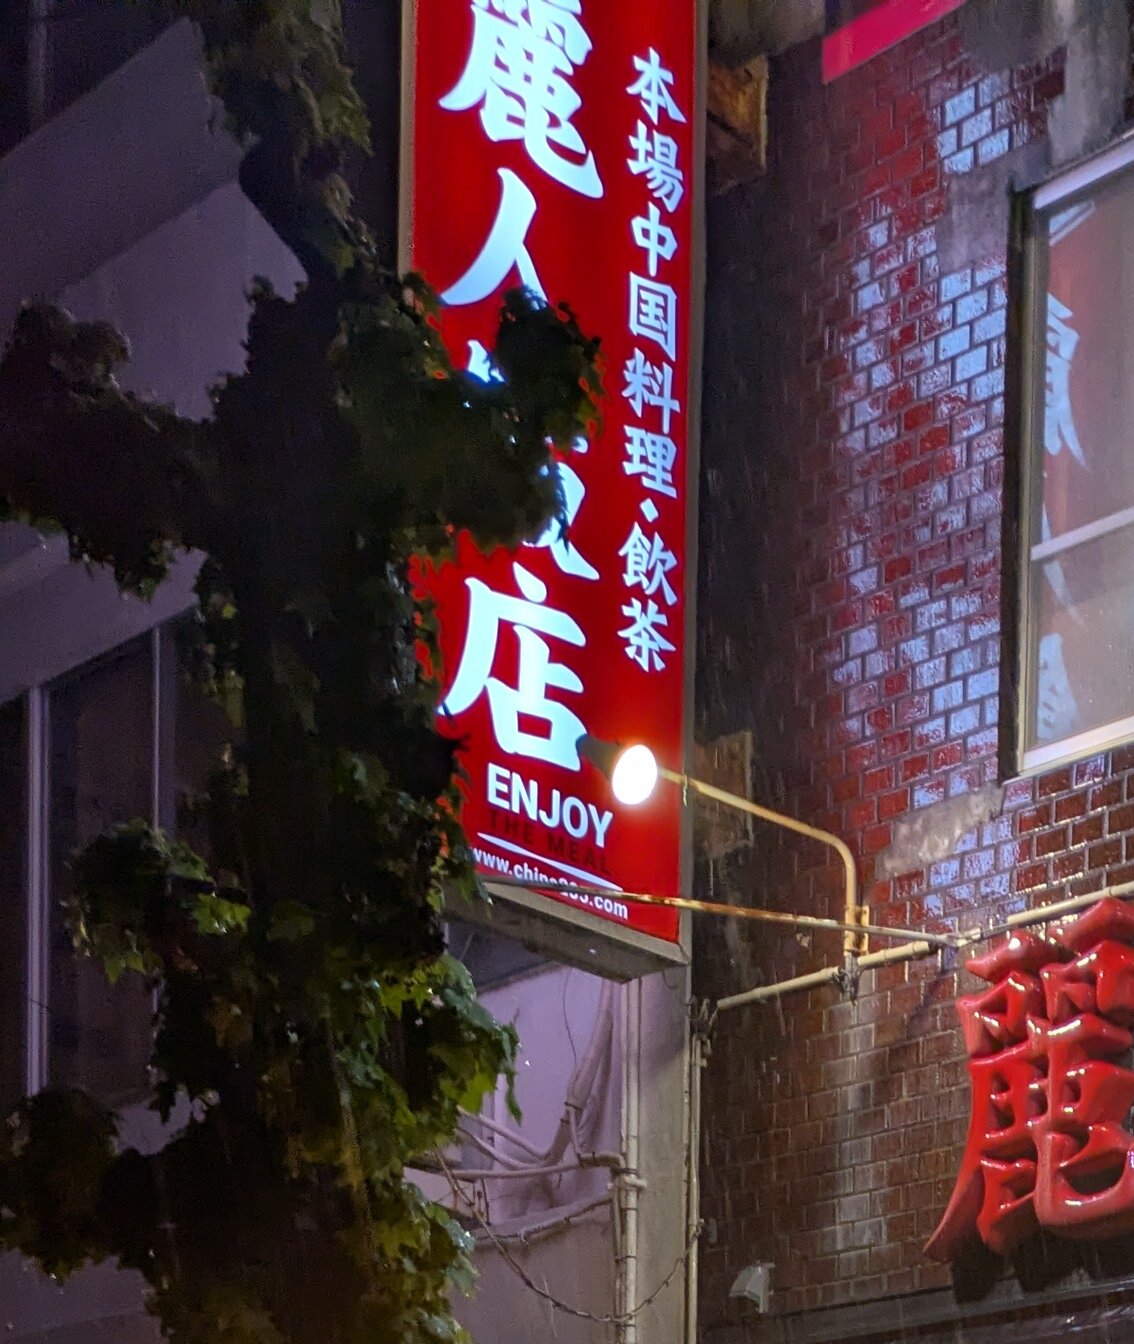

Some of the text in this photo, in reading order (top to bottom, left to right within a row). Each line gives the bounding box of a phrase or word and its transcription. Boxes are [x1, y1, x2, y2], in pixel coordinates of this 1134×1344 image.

[617, 46, 686, 674] 本場中国料理・飲茶
[486, 762, 613, 849] ENJOY
[489, 809, 611, 876] THE MEAL
